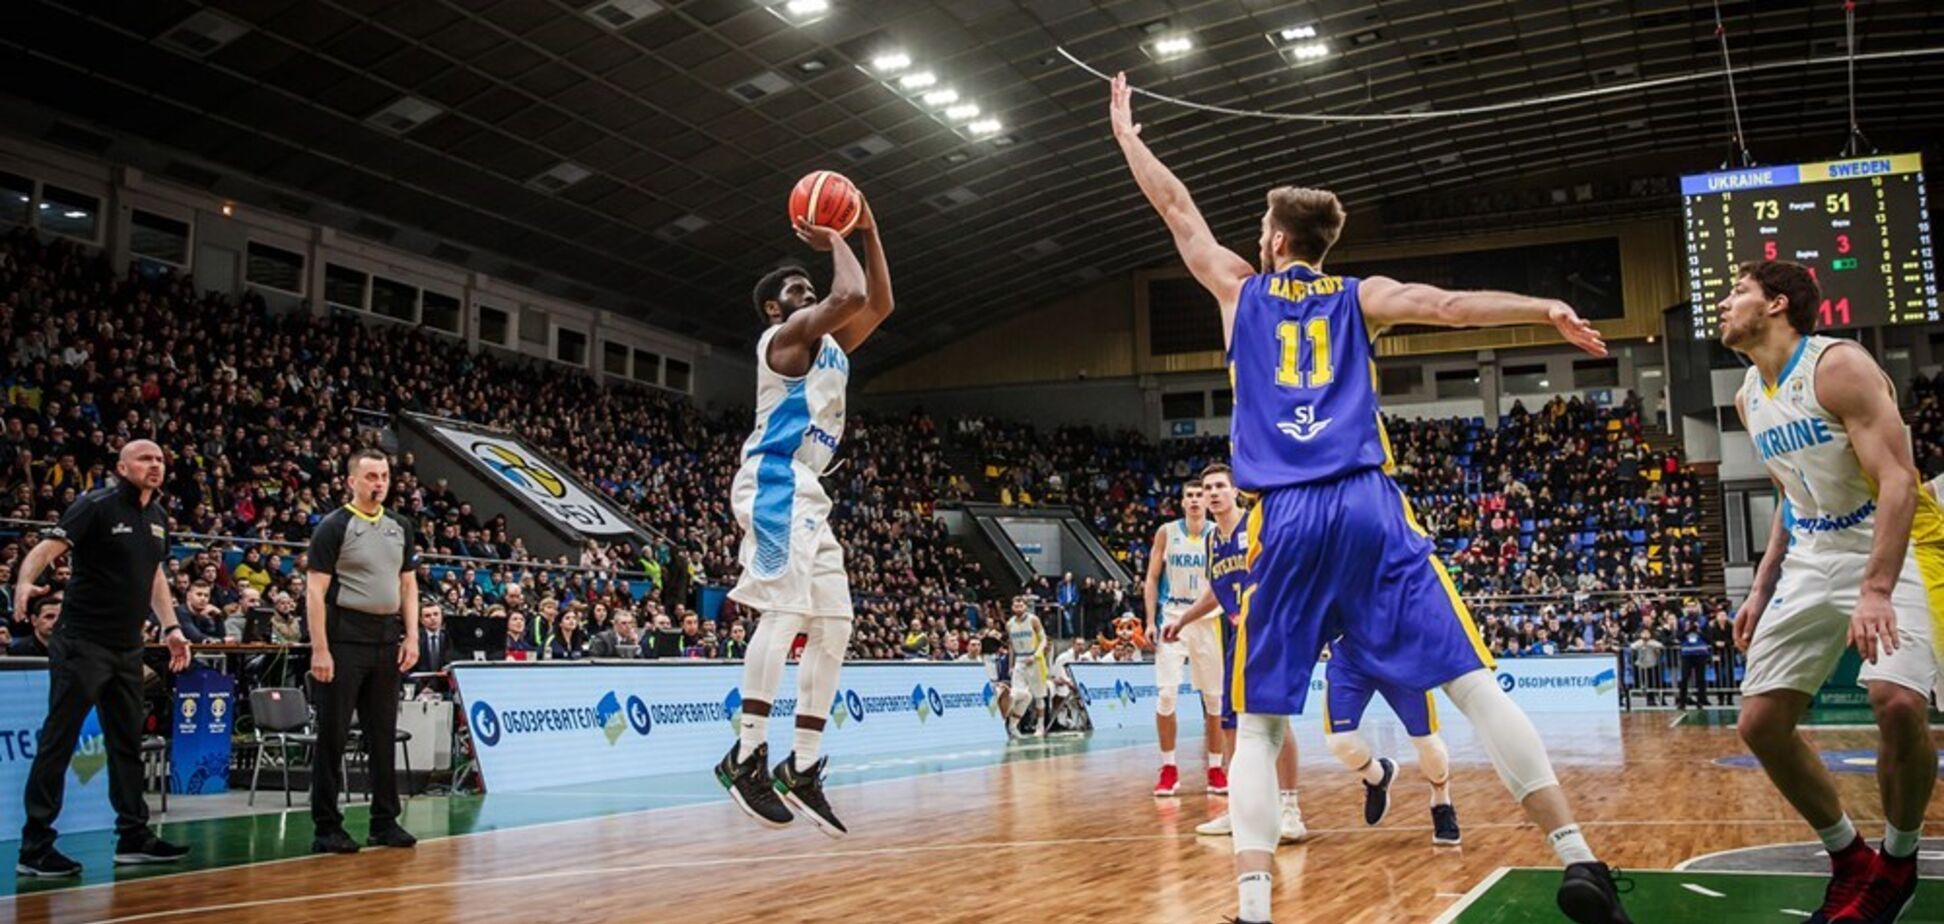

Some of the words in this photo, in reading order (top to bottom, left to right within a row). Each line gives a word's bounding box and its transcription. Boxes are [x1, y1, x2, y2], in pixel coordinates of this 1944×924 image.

[1828, 159, 1891, 178] SWEDEN
[1708, 171, 1773, 191] UKRAINE
[1753, 199, 1780, 221] 73
[1826, 192, 1851, 214] 51
[1764, 241, 1777, 260] 5
[1836, 235, 1851, 253] 3
[1275, 316, 1334, 389] 11
[1294, 405, 1315, 425] SJ
